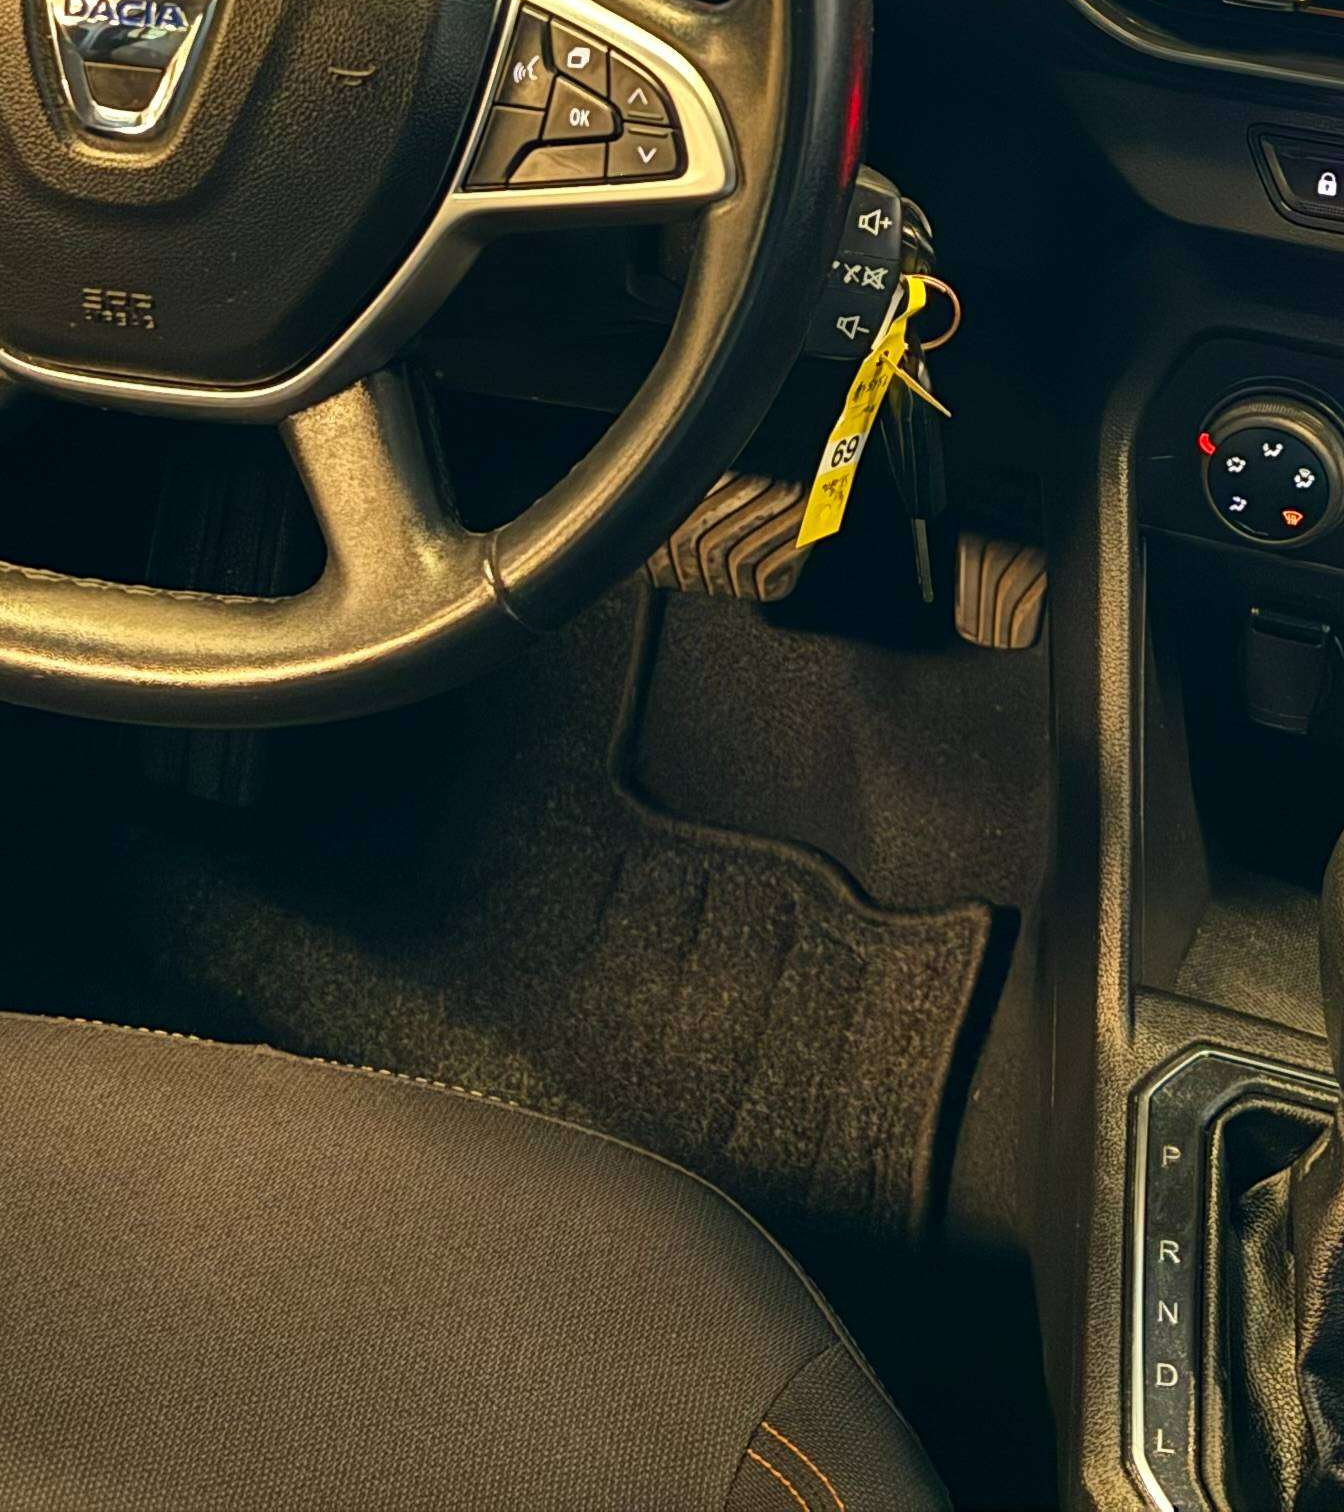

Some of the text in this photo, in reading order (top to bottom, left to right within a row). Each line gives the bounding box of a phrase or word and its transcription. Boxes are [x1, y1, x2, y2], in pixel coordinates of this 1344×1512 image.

[570, 108, 590, 127] OK
[831, 435, 860, 468] 69
[1161, 1145, 1182, 1168] P
[1158, 1240, 1181, 1263] R
[1157, 1301, 1178, 1324] N
[1156, 1363, 1178, 1387] D
[1155, 1429, 1175, 1454] L
